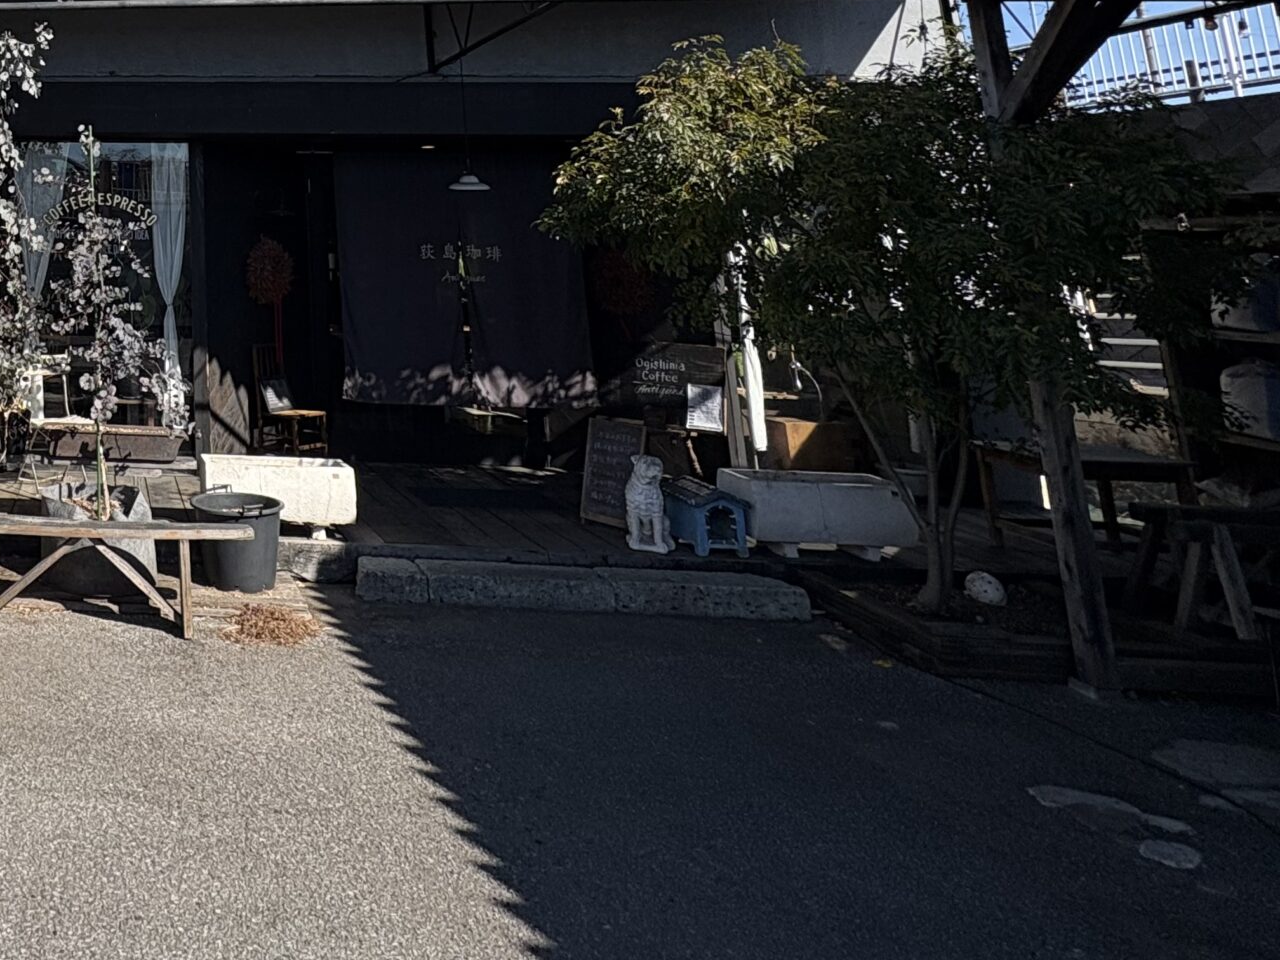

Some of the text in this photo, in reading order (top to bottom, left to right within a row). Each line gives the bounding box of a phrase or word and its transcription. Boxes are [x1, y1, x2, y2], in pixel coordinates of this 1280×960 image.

[43, 193, 87, 226] COFFEE
[98, 193, 157, 226] ESPRESSO
[635, 357, 686, 372] Ogishima
[641, 370, 679, 382] Coffee
